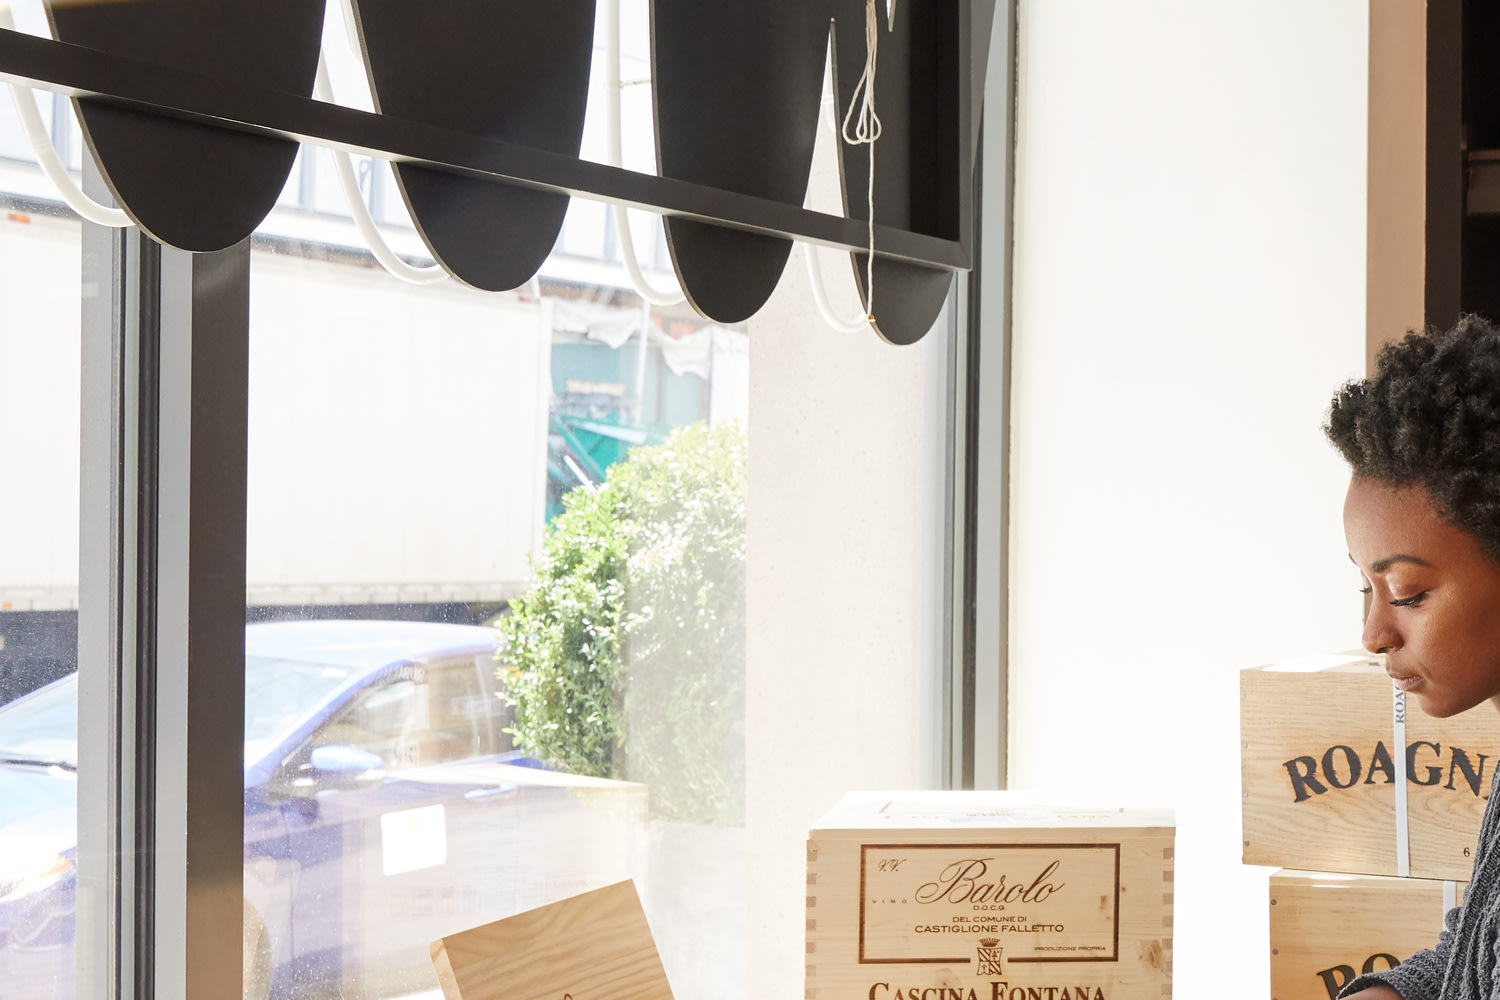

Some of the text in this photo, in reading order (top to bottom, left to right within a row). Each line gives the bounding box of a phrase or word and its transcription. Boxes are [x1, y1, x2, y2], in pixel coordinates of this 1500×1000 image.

[1394, 683, 1405, 724] ROA
[1282, 740, 1490, 803] ROAGN
[1463, 846, 1471, 858] 6
[914, 857, 1066, 905] Barolo
[914, 924, 1064, 933] CASTIGLIONE FALLETTO
[973, 915, 1016, 923] COMUNE
[1018, 915, 1027, 923] DI
